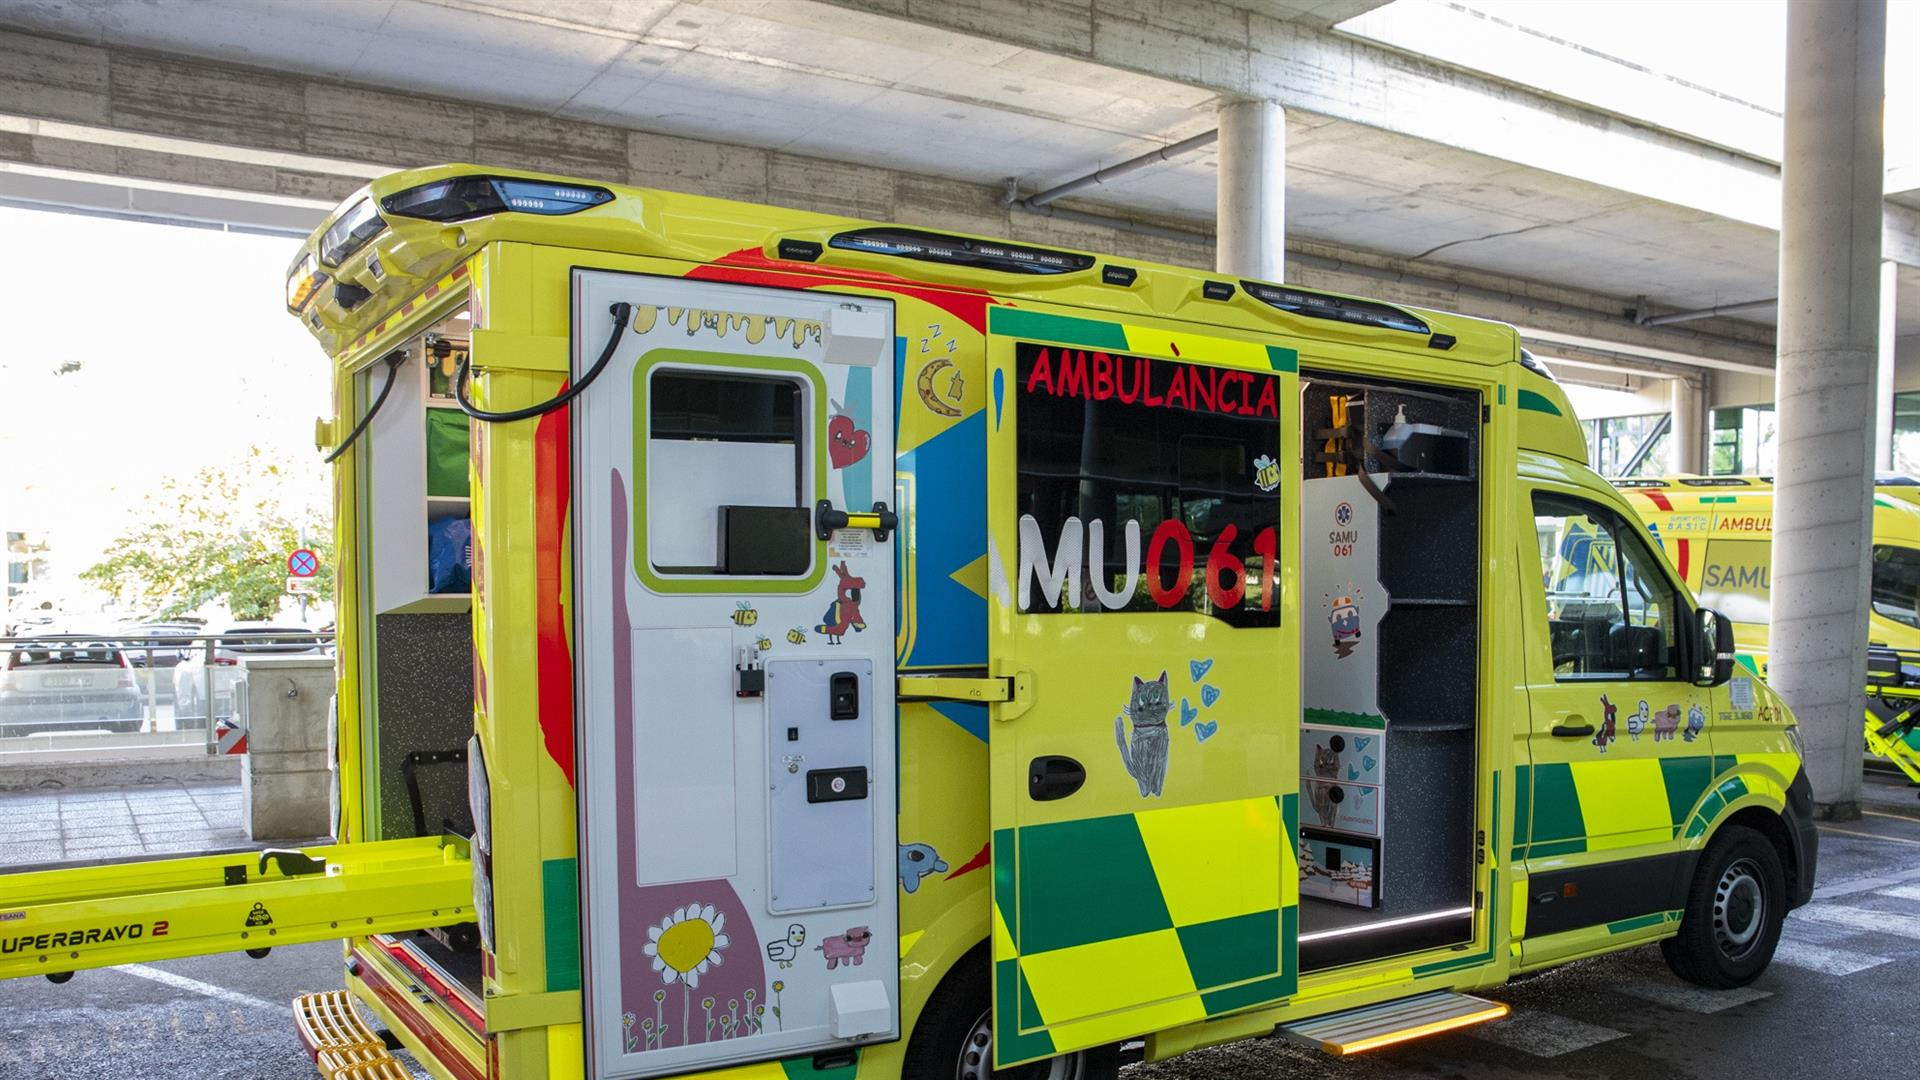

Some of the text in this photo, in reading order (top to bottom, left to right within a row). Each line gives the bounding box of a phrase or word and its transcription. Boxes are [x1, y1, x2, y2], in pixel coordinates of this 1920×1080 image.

[1667, 522, 1706, 531] BASIC
[1719, 517, 1773, 531] AMBUL
[1329, 530, 1358, 544] SAMU
[1334, 544, 1352, 557] 061
[1145, 518, 1277, 612] 061
[1, 920, 169, 954] UPERBRAVO 2
